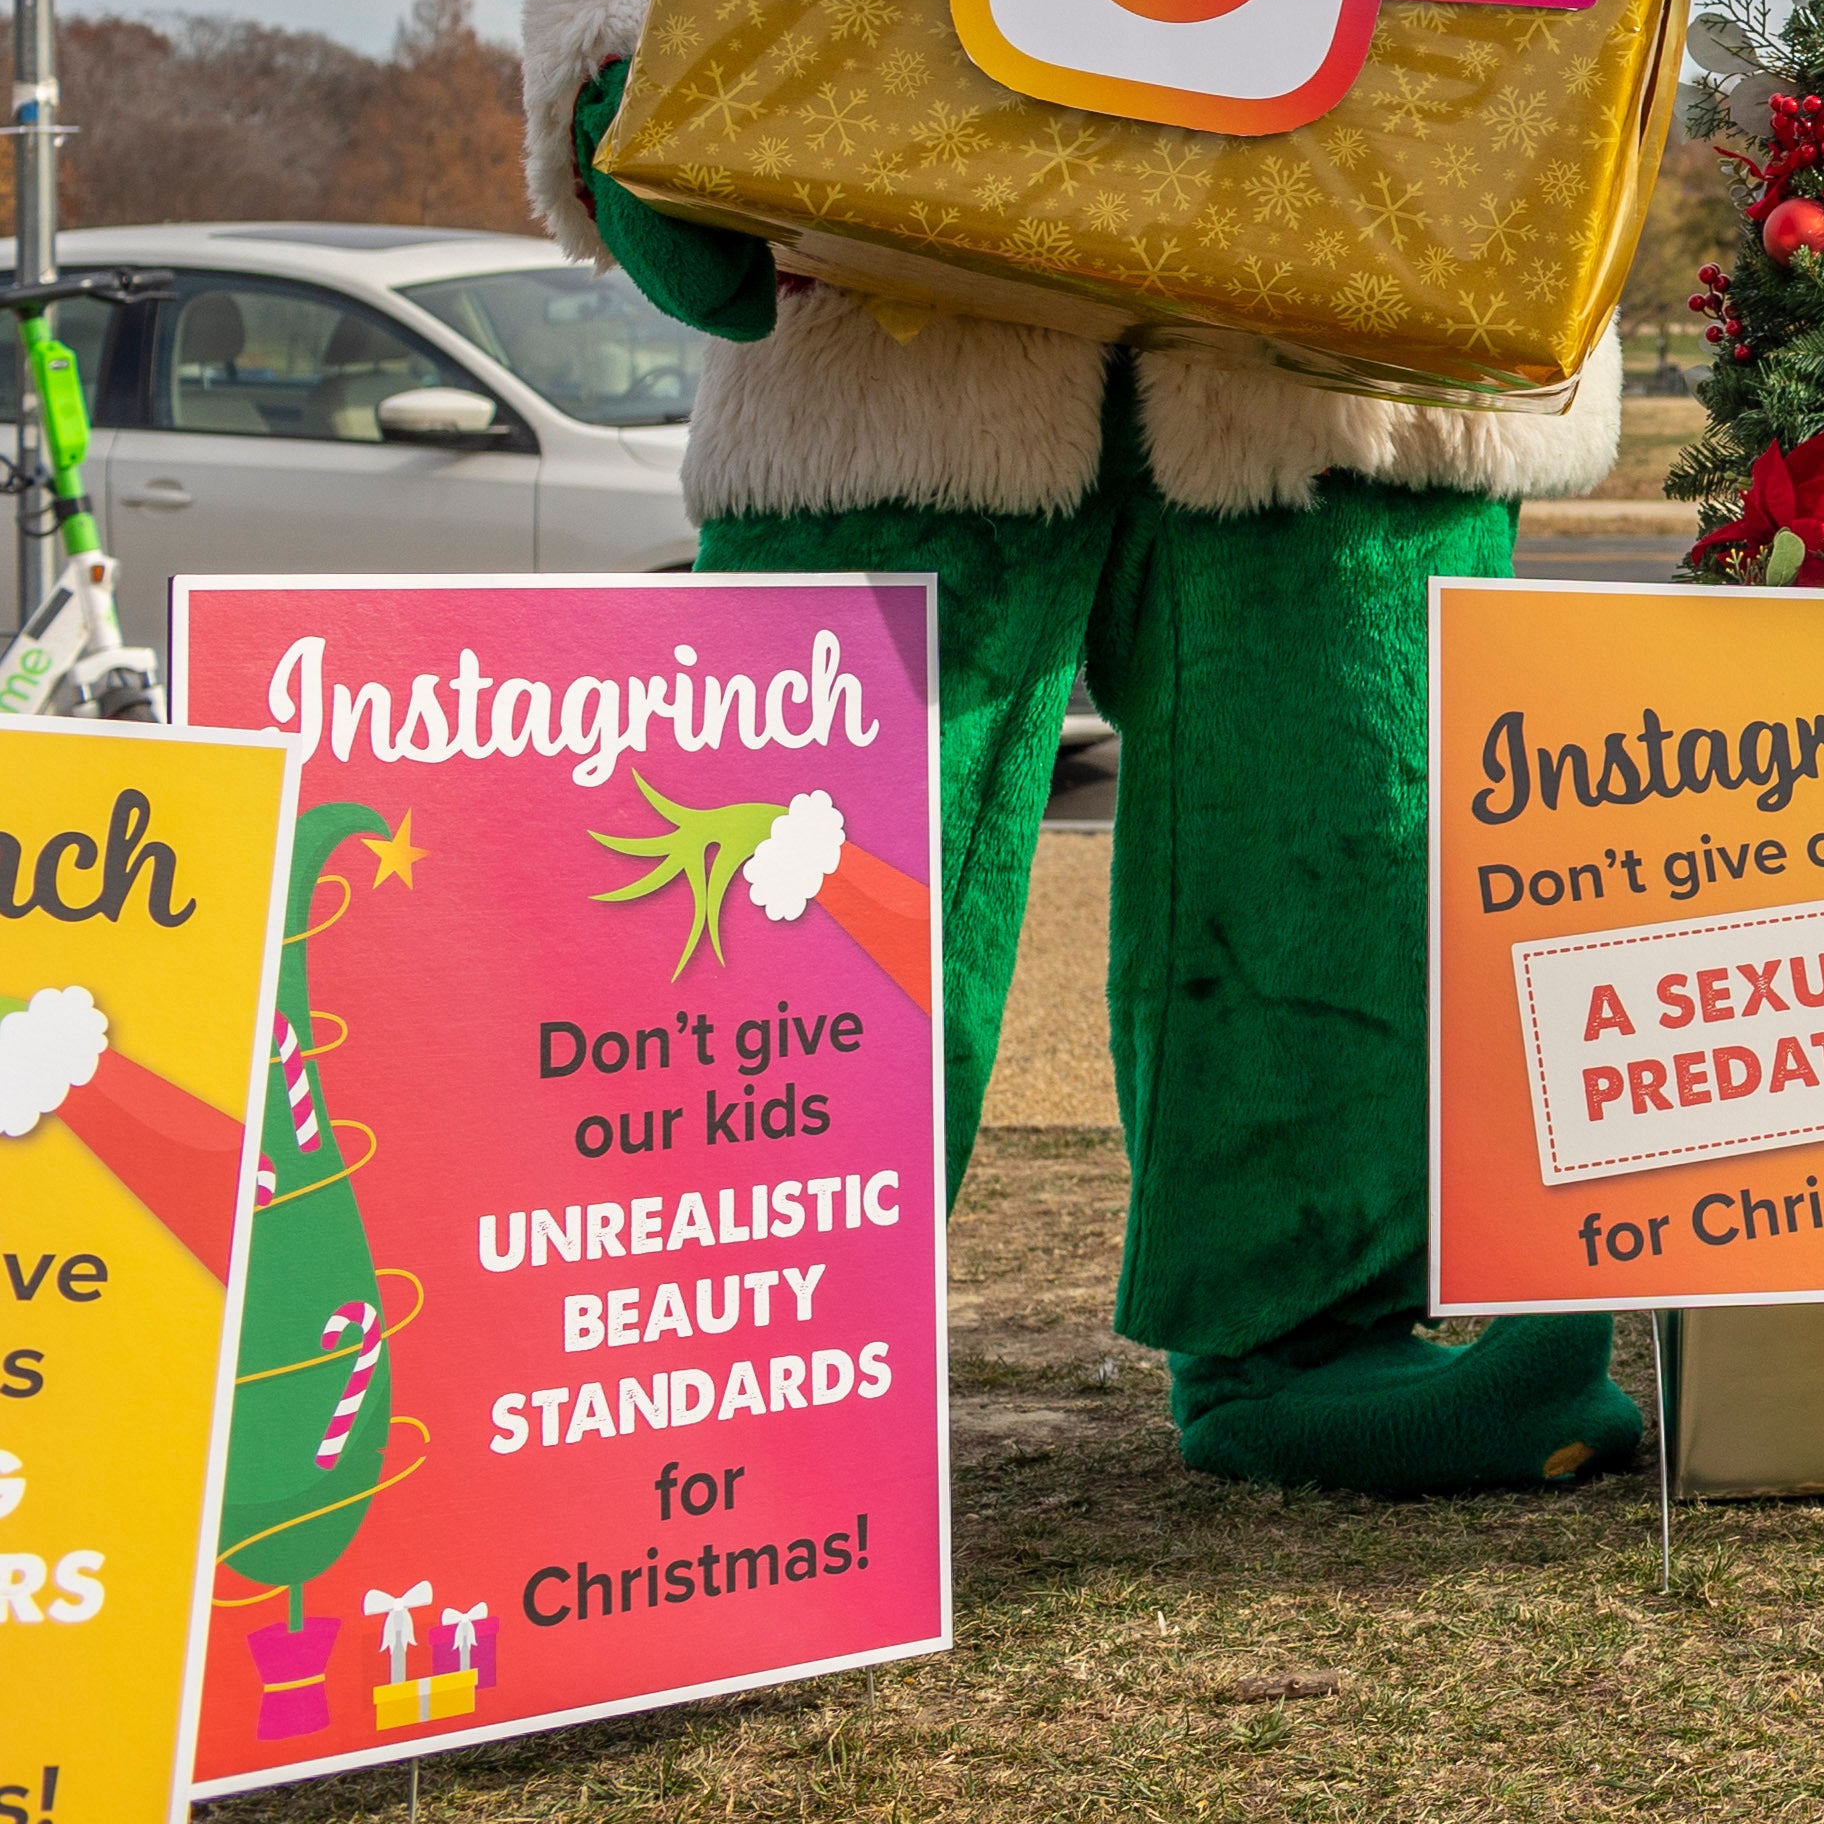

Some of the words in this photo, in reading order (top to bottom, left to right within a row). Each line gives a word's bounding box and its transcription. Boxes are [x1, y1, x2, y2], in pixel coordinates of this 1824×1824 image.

[268, 630, 879, 787] Instagrinch
[1478, 849, 1646, 913] Don't
[1664, 834, 1786, 900] give
[541, 1011, 714, 1078] Don't
[736, 1001, 863, 1075] give
[1584, 985, 1635, 1041] A
[576, 1108, 682, 1158] our
[707, 1083, 830, 1145] kids
[480, 1171, 899, 1272] UNREALISTIC
[1579, 1214, 1668, 1266] for
[565, 1264, 825, 1352] BEAUTY
[491, 1342, 891, 1453] STANDARDS
[655, 1462, 744, 1520] for
[523, 1514, 868, 1626] Christmas!
